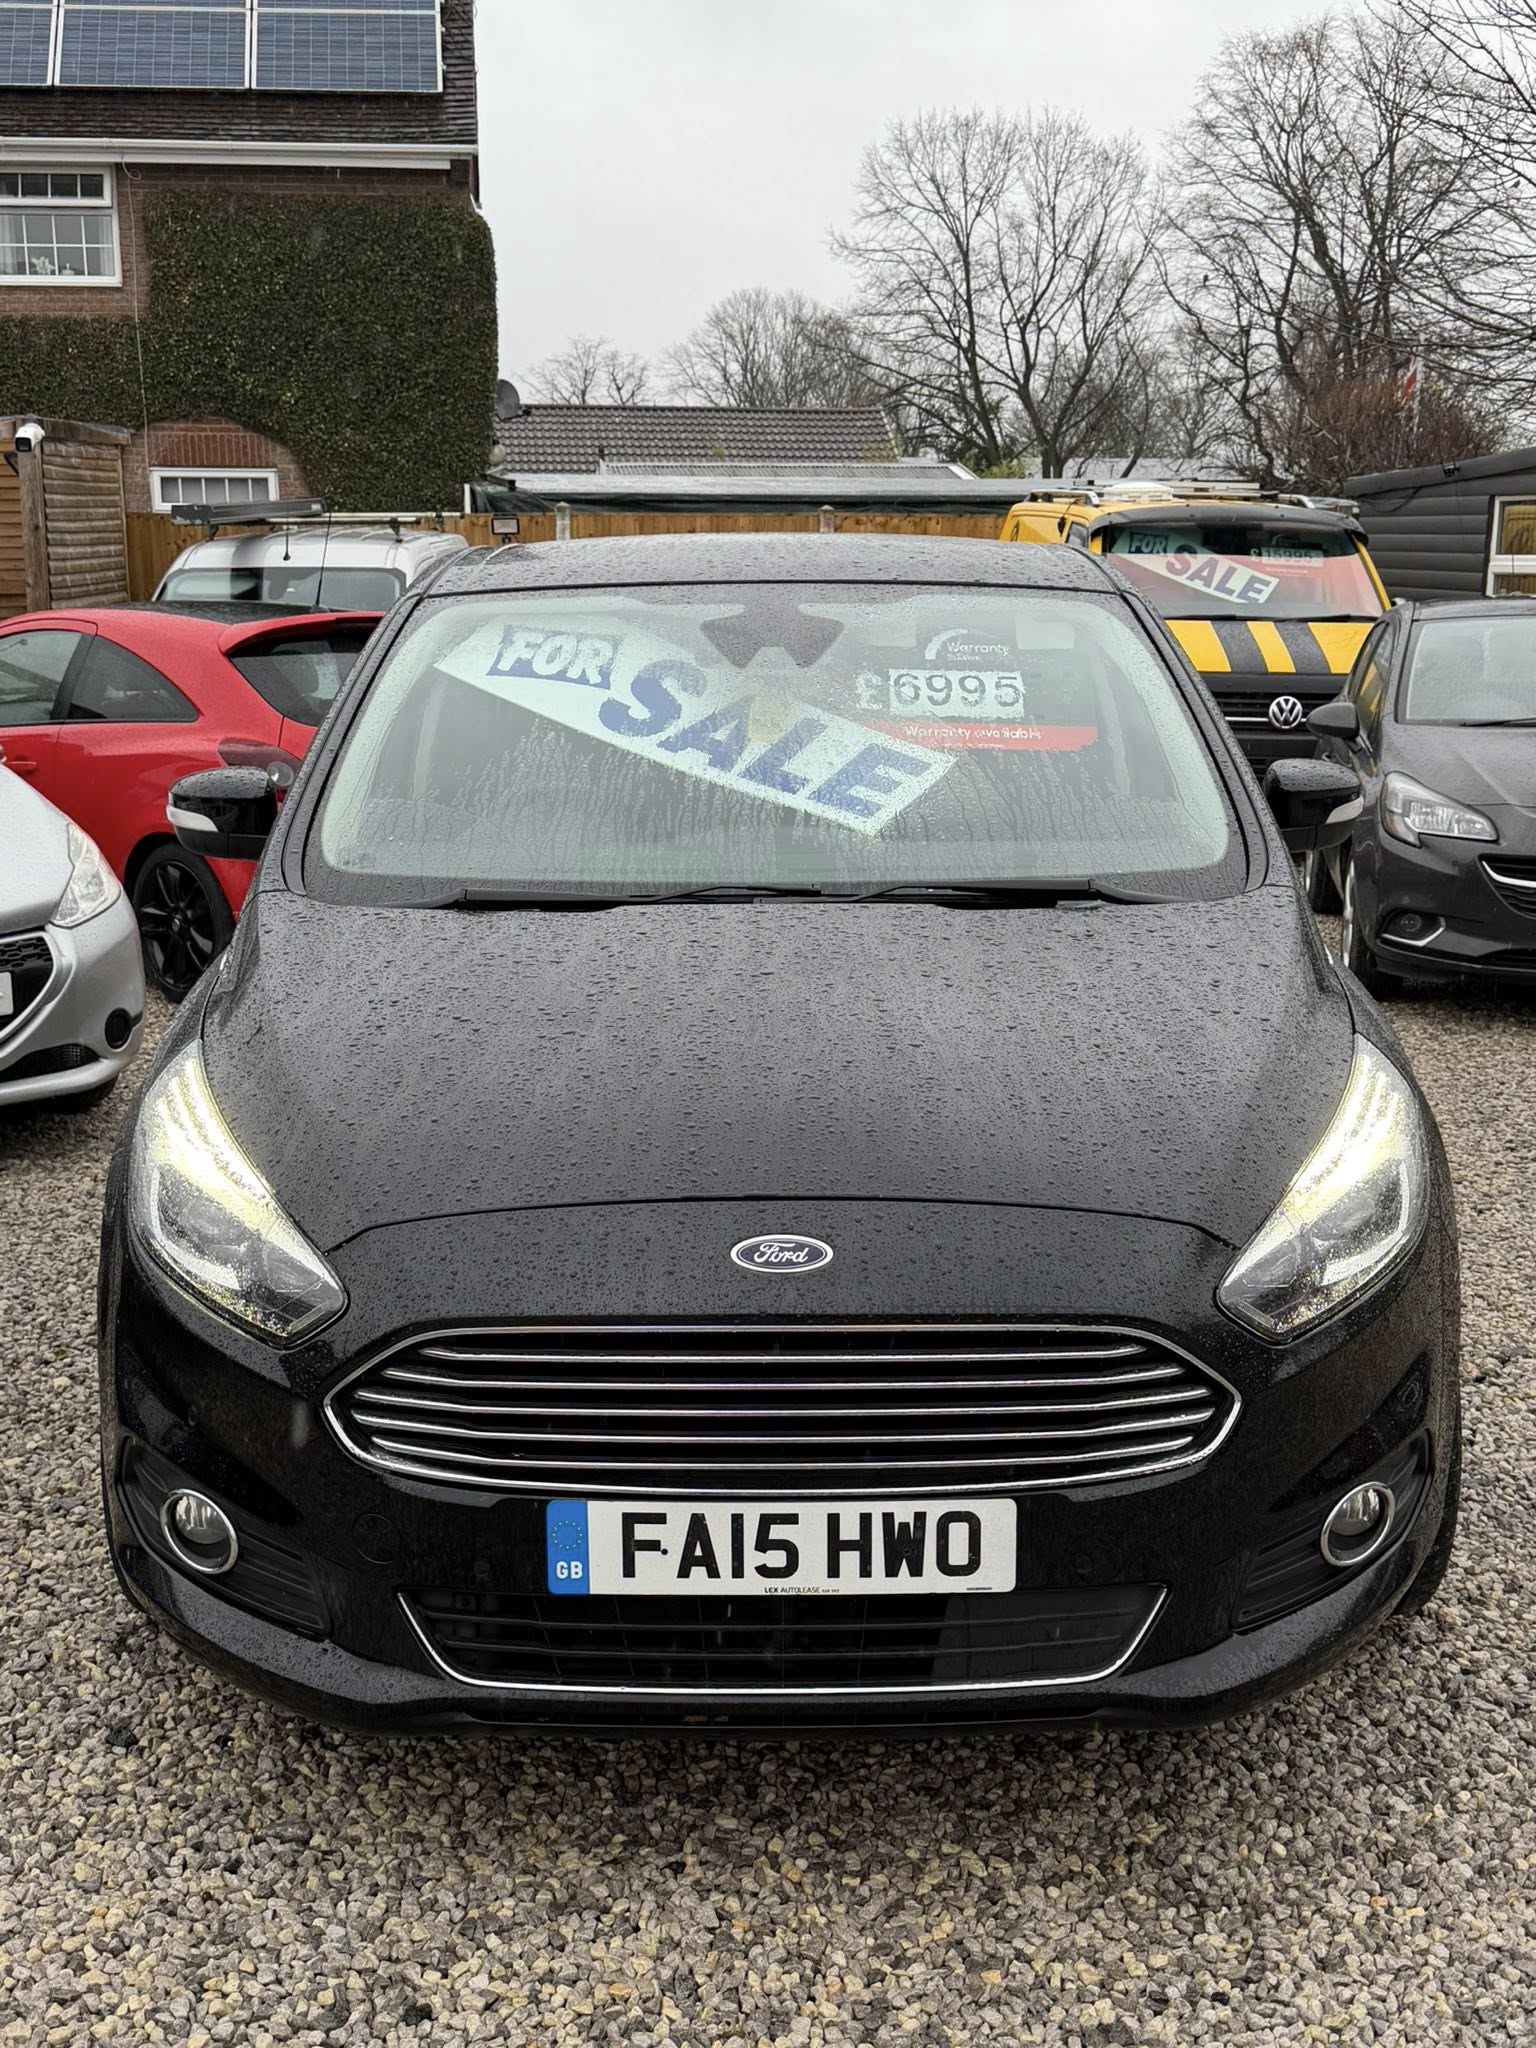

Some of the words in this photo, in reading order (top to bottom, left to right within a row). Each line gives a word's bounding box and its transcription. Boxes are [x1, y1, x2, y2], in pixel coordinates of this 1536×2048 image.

[1131, 535, 1167, 556] FOR
[1166, 545, 1271, 602] SALE
[946, 641, 1008, 656] Warranty
[497, 630, 615, 685] FOR
[599, 660, 936, 817] SALE
[904, 726, 971, 740] Warranty
[754, 1242, 809, 1262] Ford
[621, 1512, 799, 1579] FA15
[827, 1511, 981, 1579] HWO
[556, 1561, 583, 1579] GB
[764, 1586, 779, 1594] LEX
[780, 1586, 820, 1594] AUTOLEASE
